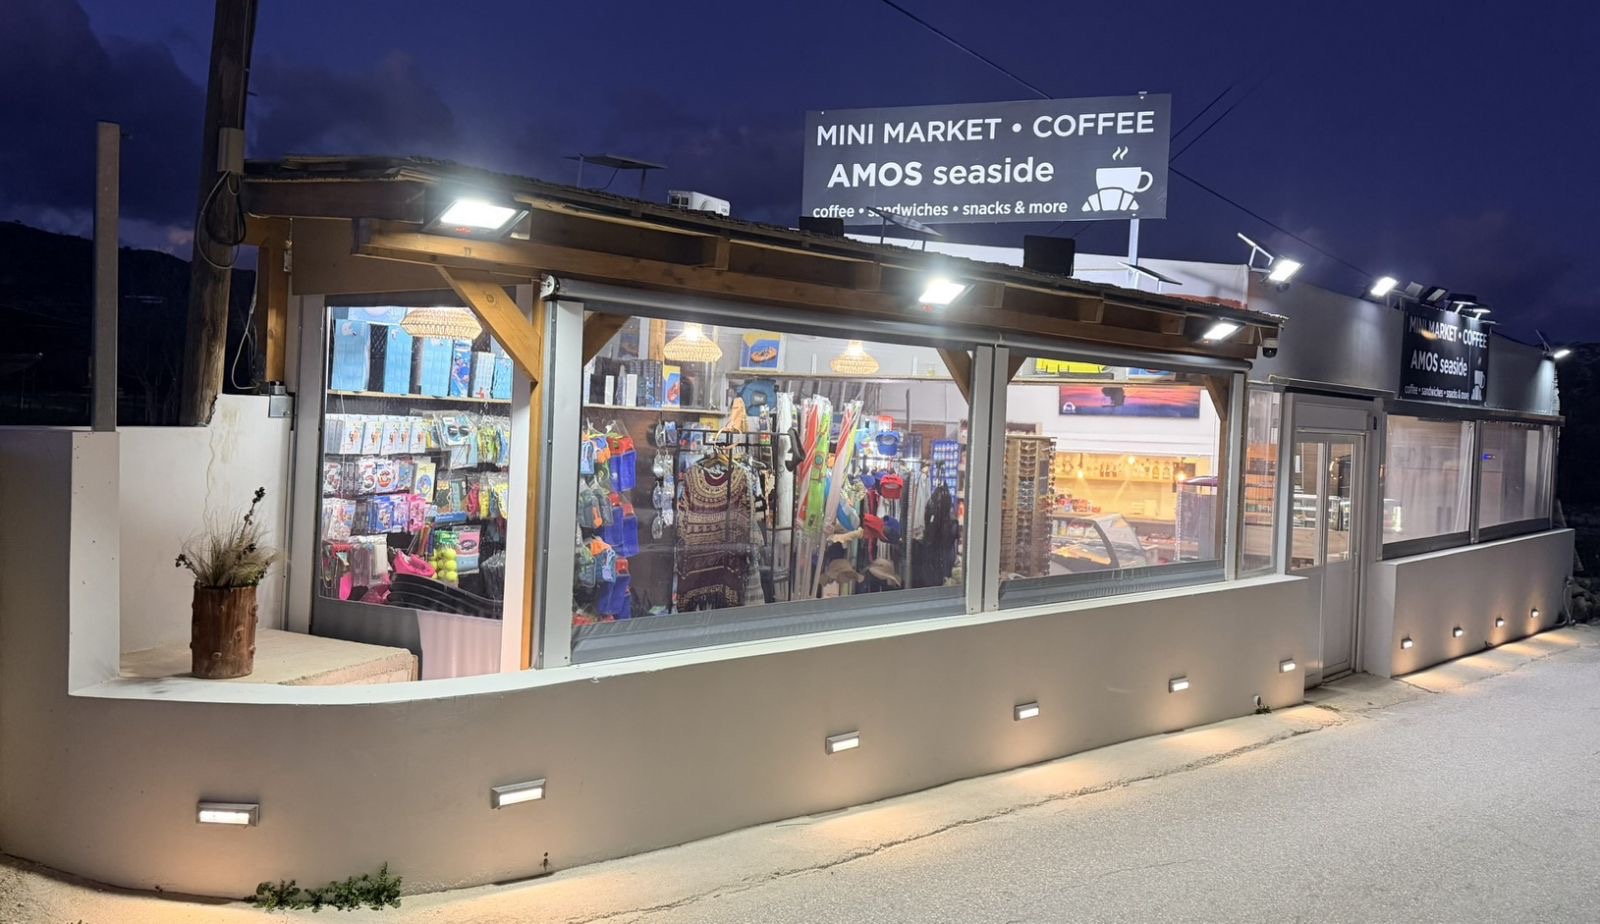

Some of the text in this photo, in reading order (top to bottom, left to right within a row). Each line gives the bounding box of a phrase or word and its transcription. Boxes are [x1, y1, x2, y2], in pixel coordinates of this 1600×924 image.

[816, 111, 1155, 146] MINI MARKET COFFEE
[827, 156, 1055, 188] AMOS seaside
[812, 204, 855, 218] coffee
[962, 200, 1012, 216] snacks
[1014, 200, 1026, 215] &
[1028, 201, 1068, 214] more
[1463, 329, 1487, 348] COFFEE
[1410, 350, 1468, 376] AMOS seaside
